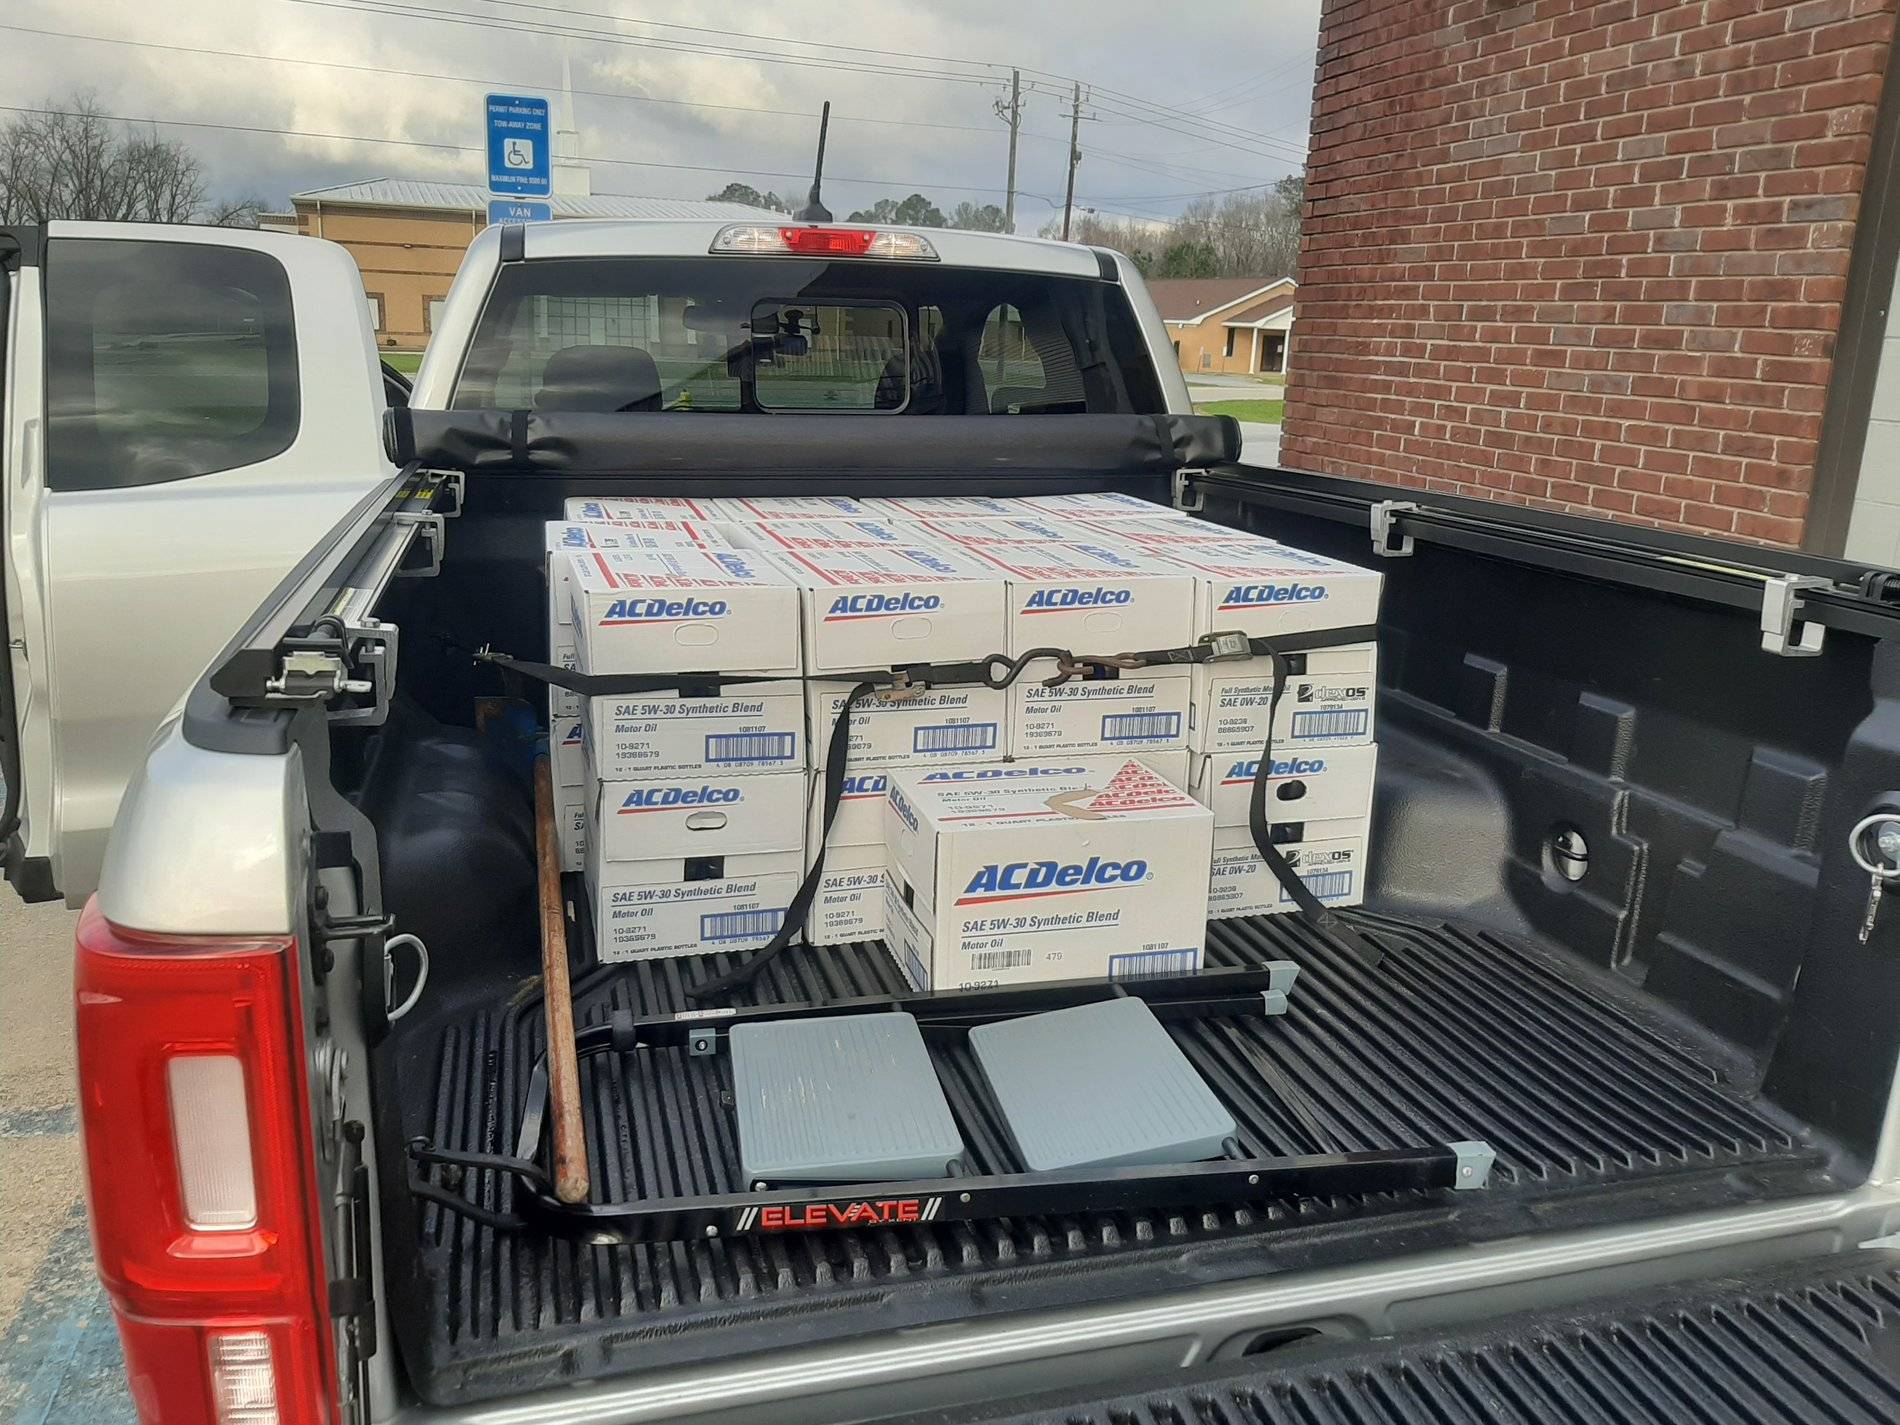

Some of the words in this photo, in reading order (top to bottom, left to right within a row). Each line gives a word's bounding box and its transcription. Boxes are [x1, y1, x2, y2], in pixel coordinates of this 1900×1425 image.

[509, 106, 531, 115] PARKING
[532, 108, 545, 116] ONLY
[526, 122, 543, 130] ZONE
[509, 207, 532, 217] VAN
[1025, 587, 1131, 608] ACDelco
[1222, 583, 1326, 604] ACDelco
[604, 597, 727, 619] ACDelco
[828, 592, 941, 614] ACDelco
[1026, 688, 1046, 698] SAE
[1048, 687, 1079, 698] 5W-30
[1080, 685, 1125, 697] Synthetic
[1127, 684, 1155, 694] Blend
[1234, 686, 1261, 694] Synthetic
[832, 699, 850, 710] SA
[855, 698, 888, 709] 5W-30
[890, 697, 937, 709] Synthetic
[939, 695, 968, 705] Blend
[1220, 698, 1239, 707] SAE
[1240, 697, 1269, 706] 0W-20
[615, 703, 638, 716] SAE
[640, 703, 676, 715] 5W-30
[678, 702, 730, 715] Synthetic
[731, 702, 763, 713] Blend
[1025, 706, 1049, 714] Motor
[1050, 705, 1062, 713] Oil
[858, 717, 870, 725] Oil
[615, 724, 642, 733] Motor
[643, 723, 657, 732] Oil
[923, 767, 1086, 781] ACDelco
[622, 785, 741, 807] ACDelco
[1089, 797, 1185, 807] ACDelco
[963, 856, 1148, 893] ACDelco
[1228, 864, 1256, 874] 0W-20
[824, 878, 845, 888] SAE
[846, 875, 878, 886] 5W-30
[612, 892, 635, 903] SAE
[637, 889, 671, 901] 5W-30
[673, 884, 723, 899] Synthetic
[725, 882, 756, 894] Blend
[824, 895, 848, 904] Motor
[849, 893, 862, 902] Oil
[612, 910, 638, 919] Motor
[640, 908, 653, 917] Oil
[962, 919, 987, 933] SAE
[989, 917, 1027, 930] 5W-30
[1029, 913, 1083, 929] Synthetic
[1086, 909, 1121, 922] Blend
[961, 941, 988, 950] Motor
[990, 939, 1003, 948] Oil
[761, 1199, 919, 1226] ELEVATE
